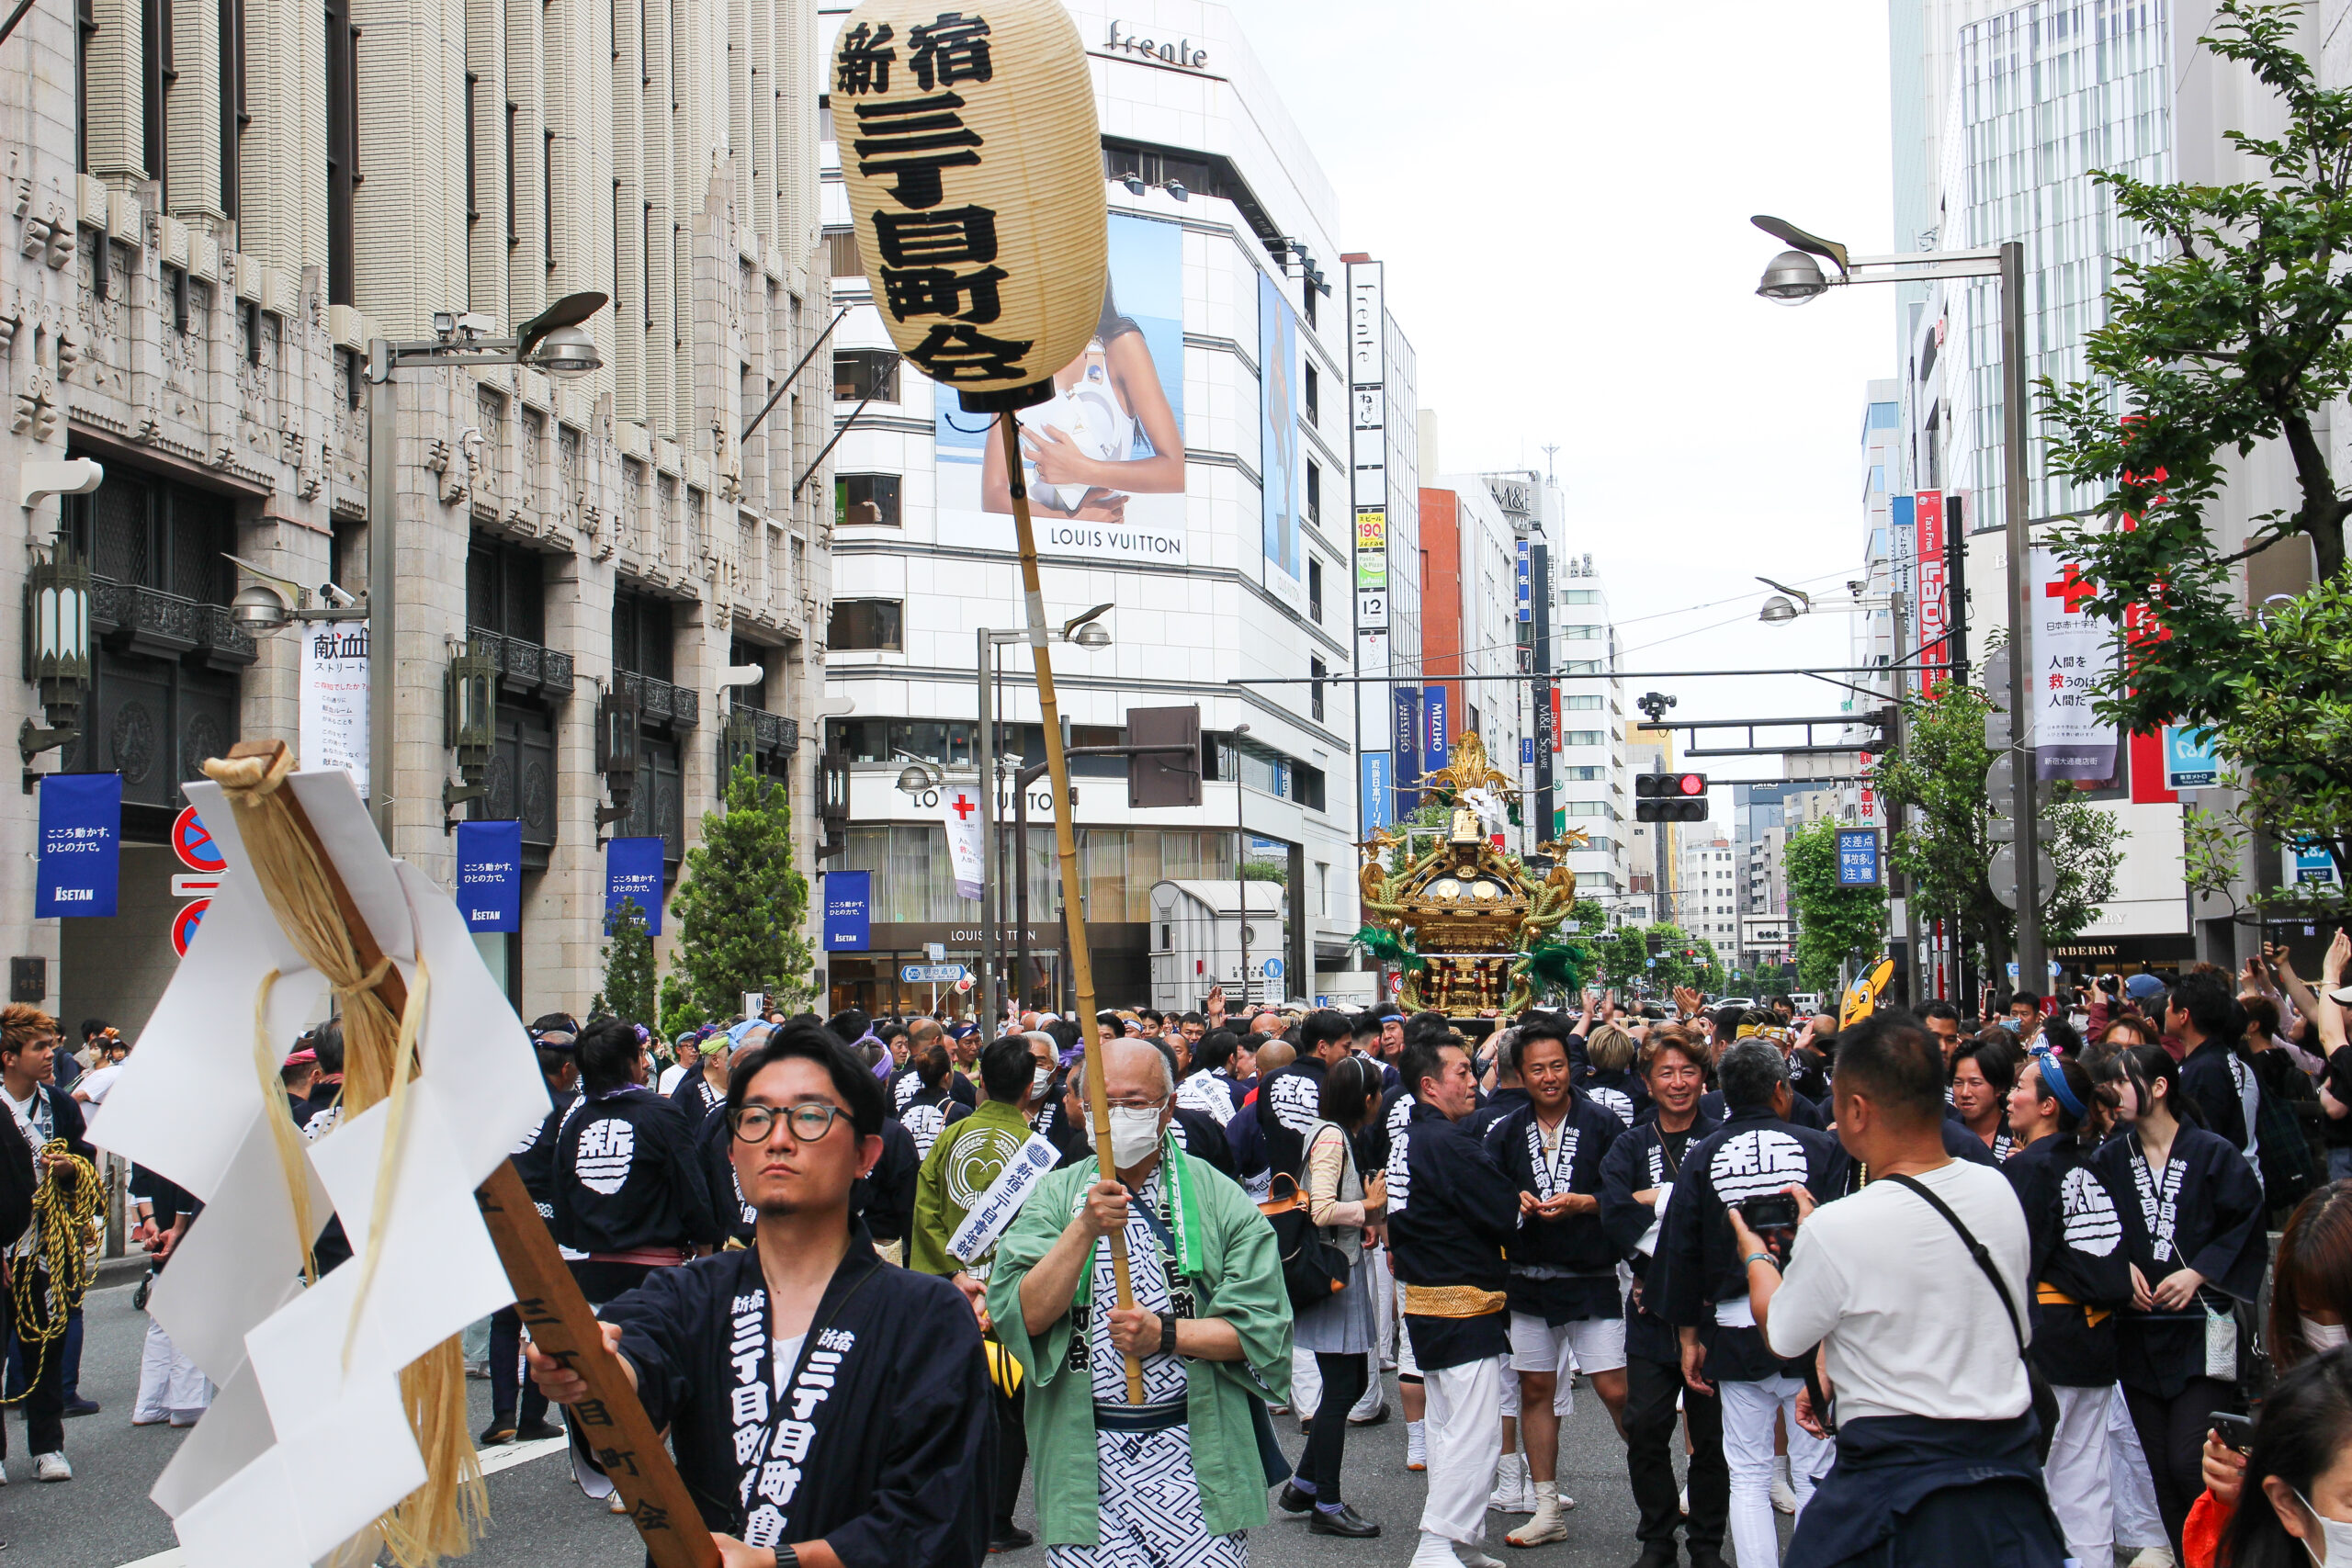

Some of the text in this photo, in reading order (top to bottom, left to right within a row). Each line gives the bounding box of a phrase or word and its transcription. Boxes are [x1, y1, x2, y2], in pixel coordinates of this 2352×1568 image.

[1359, 393, 1374, 423] ねぎし
[1924, 514, 1935, 552] Tax Free
[1050, 527, 1182, 554] LOUIS VUITTON
[1920, 560, 1944, 644] Laox
[2046, 619, 2098, 632] 日本赤十字社
[313, 632, 367, 660] 献血
[314, 662, 366, 673] ストリート
[2048, 655, 2087, 670] 人間を
[2048, 672, 2097, 691] 救うのは
[1539, 704, 1550, 731] M&E
[1431, 703, 1442, 752] MIZUHO
[2044, 756, 2098, 767] 新宿大通商店街
[47, 826, 110, 840] こころ動かす、
[47, 841, 101, 853] ひとの力で。
[1841, 834, 1874, 848] 交差点
[1842, 853, 1874, 866] 事故多し
[463, 862, 514, 873] こころ動かす、
[1843, 867, 1873, 881] 注意
[463, 874, 506, 884] ひとの力で。
[611, 874, 657, 884] こころ動かす、
[54, 886, 94, 902] ISETAN
[612, 884, 650, 893] ひとの力で。
[828, 900, 865, 908] こころ動かす、
[471, 908, 501, 921] ISETAN
[829, 908, 861, 917] ひとの力で。
[922, 967, 956, 976] 明治通り
[956, 1161, 1035, 1258] 新宿三丁目青年部
